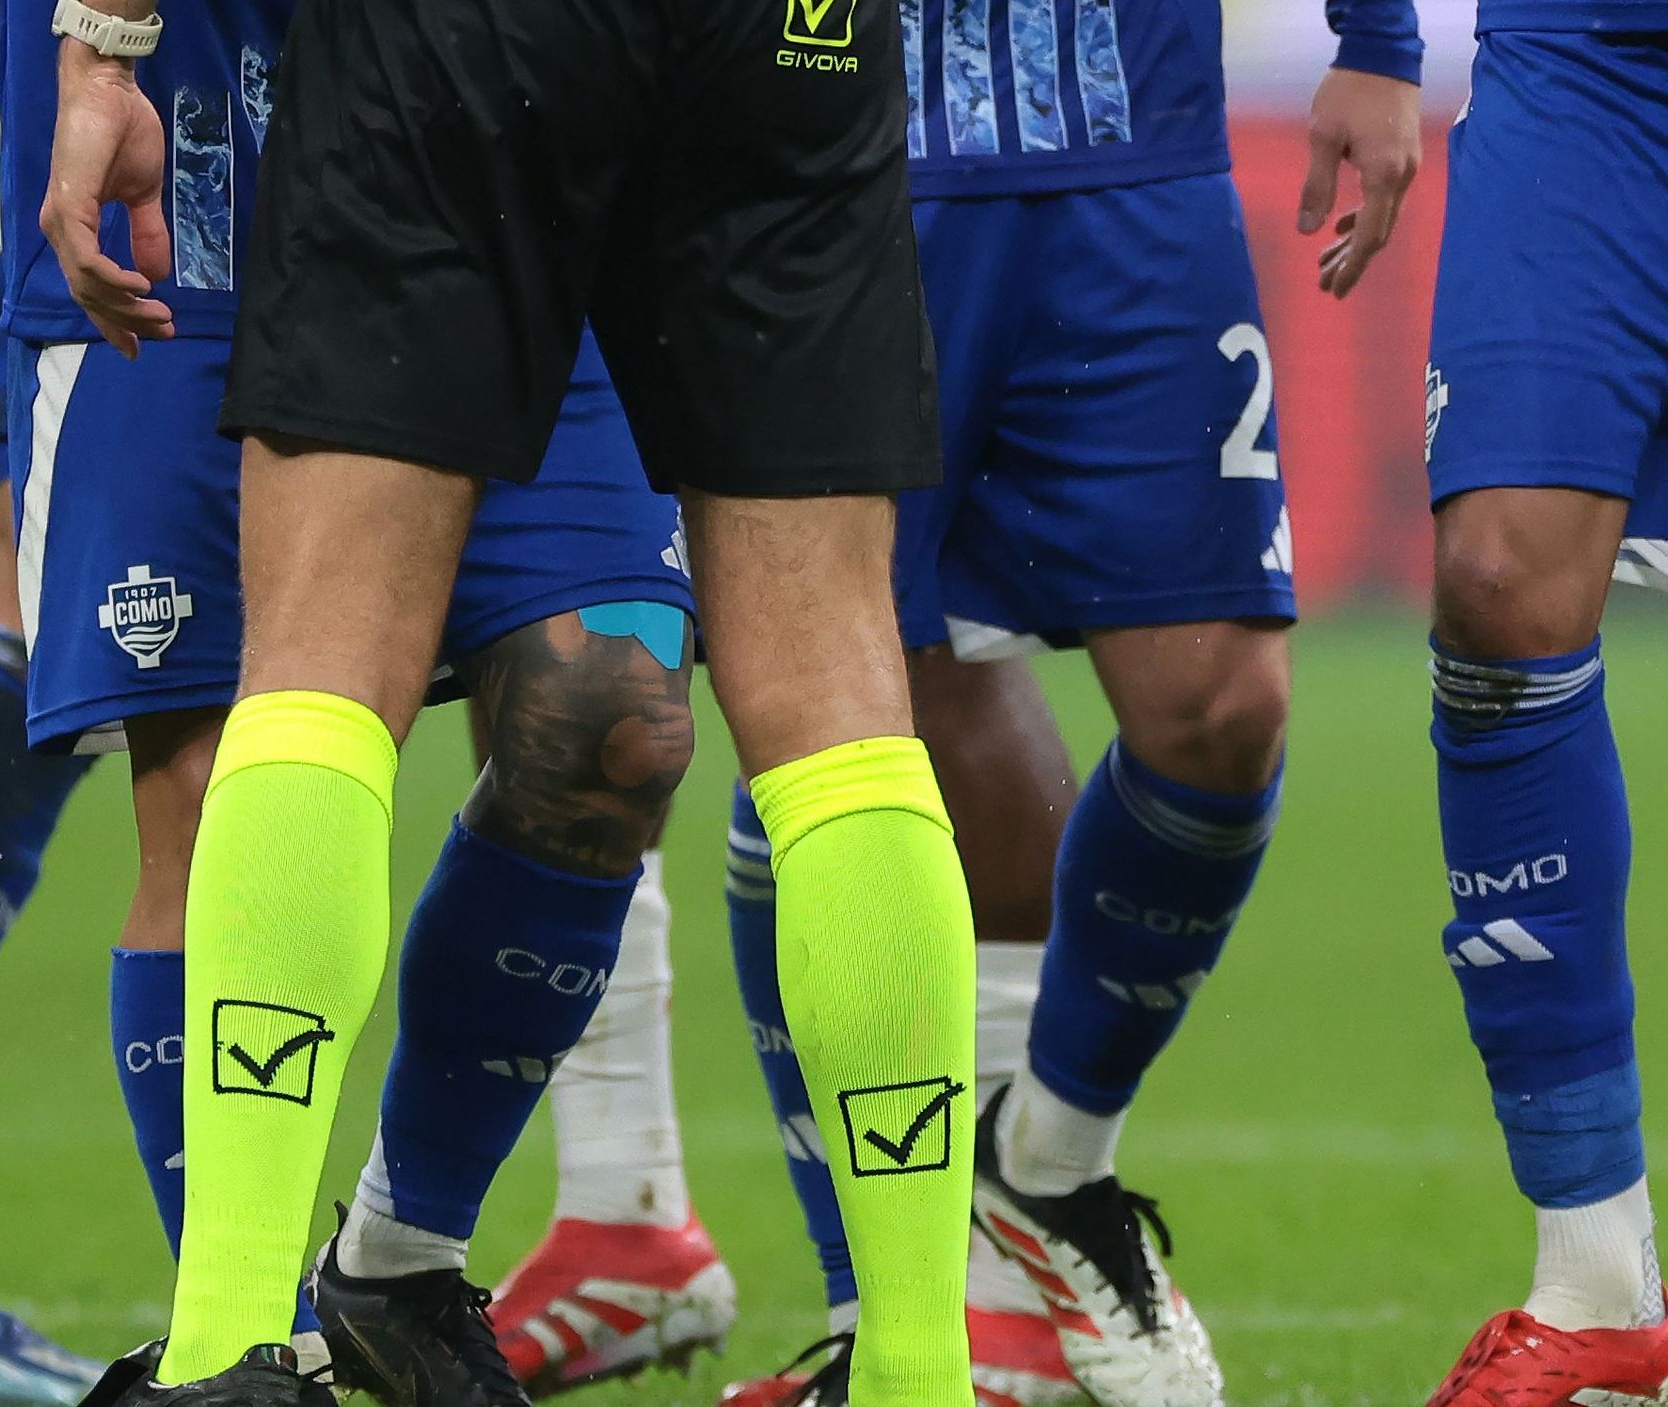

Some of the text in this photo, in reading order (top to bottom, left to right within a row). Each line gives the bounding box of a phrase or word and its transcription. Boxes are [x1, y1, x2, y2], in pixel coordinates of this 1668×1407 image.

[776, 49, 858, 73] GIVOVA
[1217, 323, 1278, 480] 2
[124, 586, 157, 600] 1907
[115, 596, 172, 626] COMO
[1450, 853, 1568, 897] OMO
